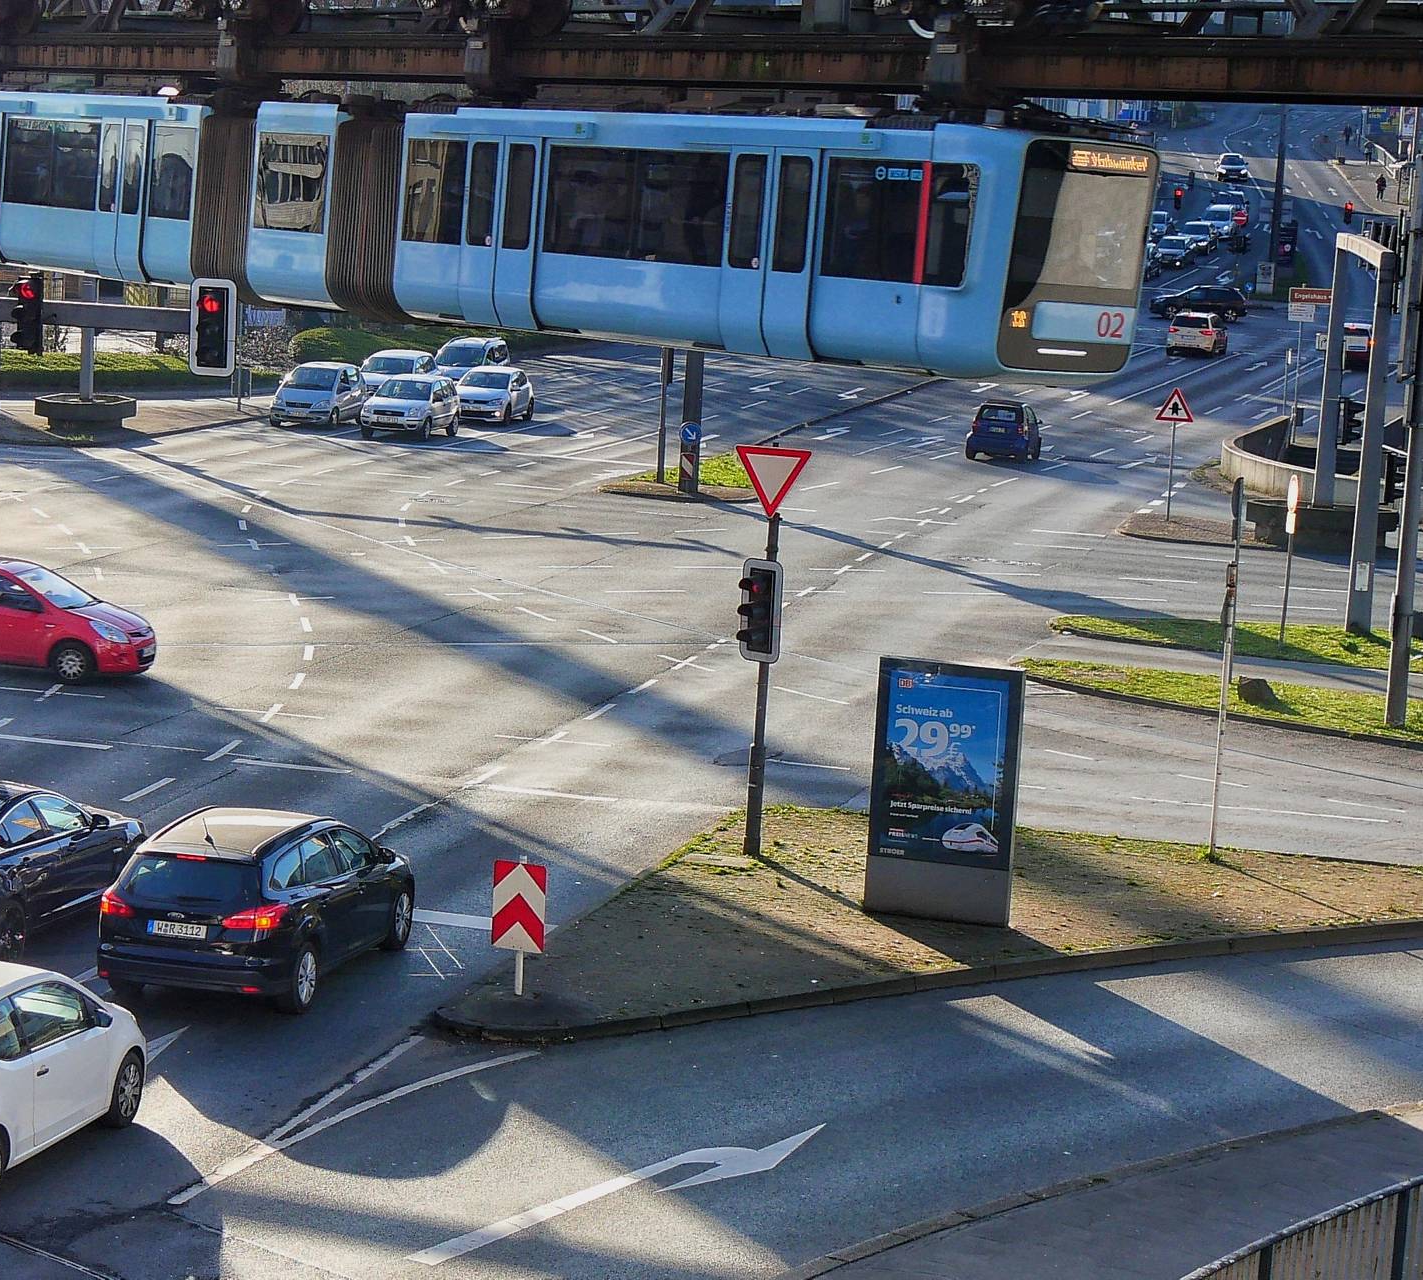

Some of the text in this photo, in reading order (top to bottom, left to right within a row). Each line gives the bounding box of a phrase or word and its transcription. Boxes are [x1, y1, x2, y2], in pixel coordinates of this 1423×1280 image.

[1097, 312, 1126, 338] 02
[896, 704, 953, 718] Schweiz ab
[890, 800, 972, 815] Jetzt Sparpreise sichern!
